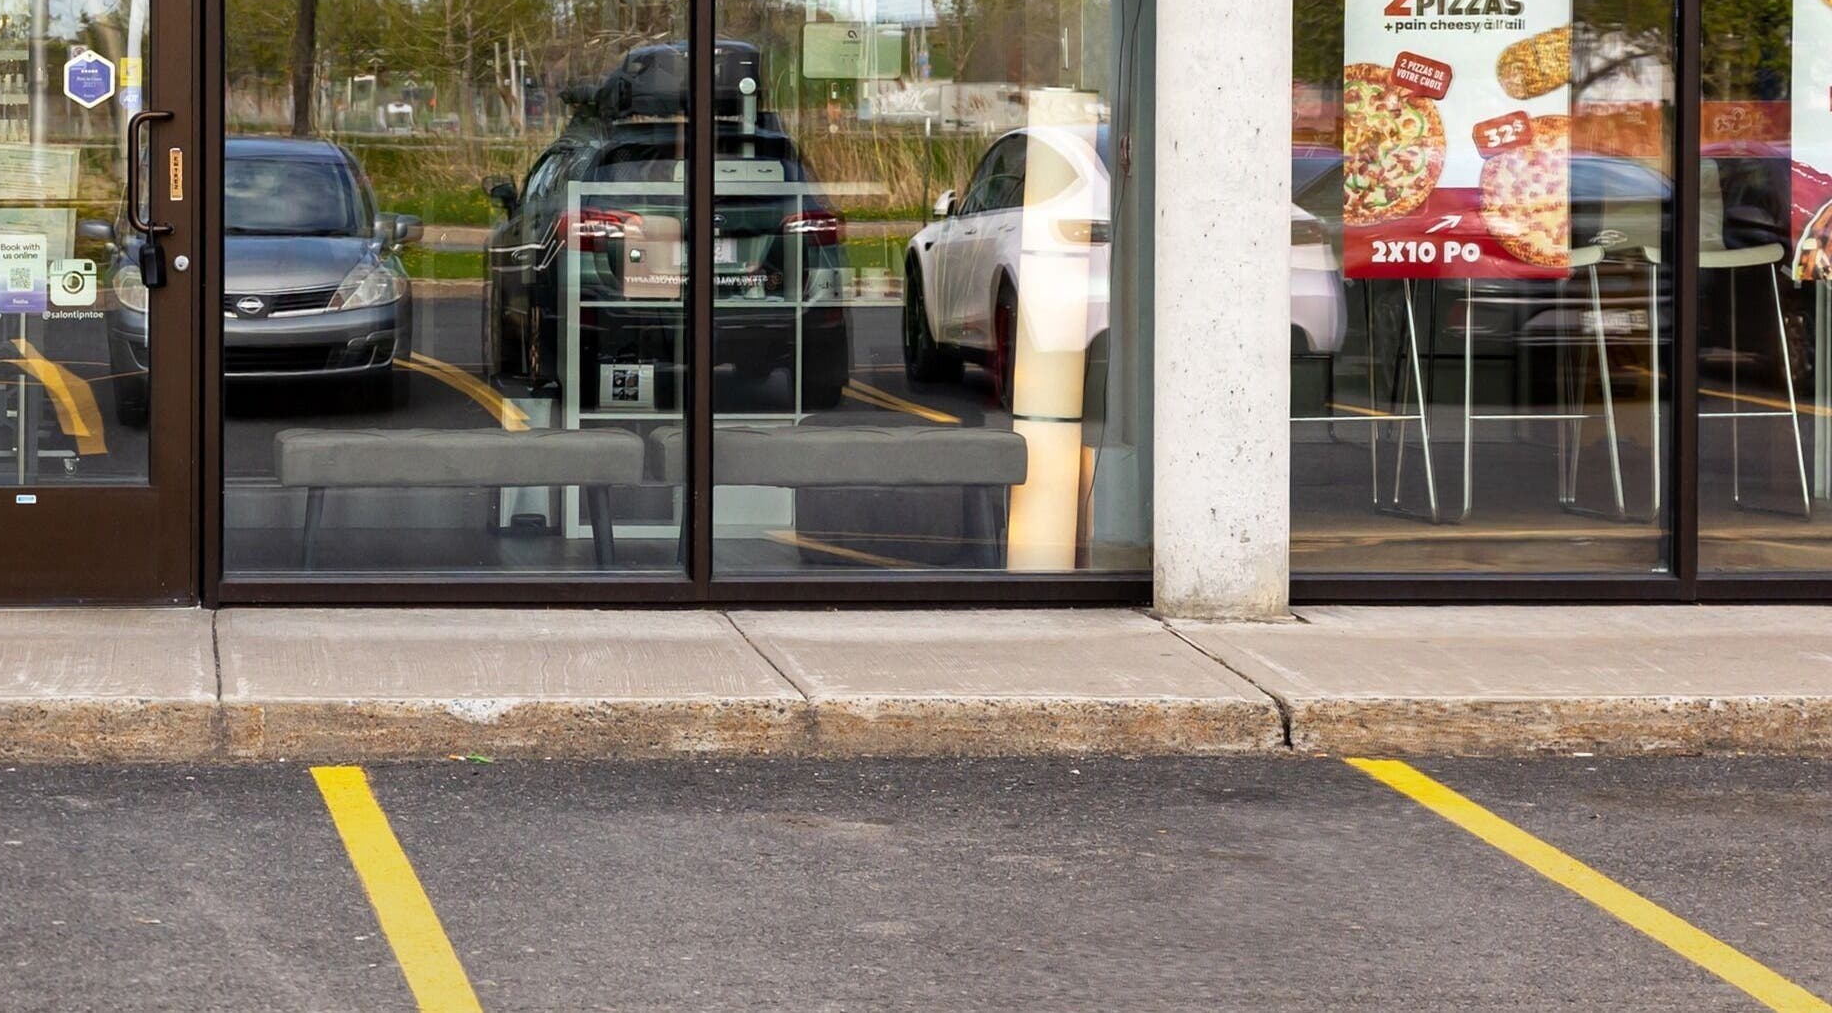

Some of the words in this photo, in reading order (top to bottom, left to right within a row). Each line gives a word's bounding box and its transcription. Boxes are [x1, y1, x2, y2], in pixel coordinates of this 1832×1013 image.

[1395, 19, 1427, 33] pain
[1430, 19, 1481, 33] cheesy
[1400, 58, 1408, 68] 2
[1407, 61, 1434, 77] PIZZAS
[1434, 70, 1445, 81] DE
[1396, 68, 1420, 83] VOTRE
[1420, 76, 1443, 91] CHOIX
[0, 243, 20, 251] Book
[23, 243, 41, 251] with
[1371, 241, 1437, 263] 2X10
[1443, 241, 1481, 263] PO
[42, 310, 104, 320] @salontipntoe
